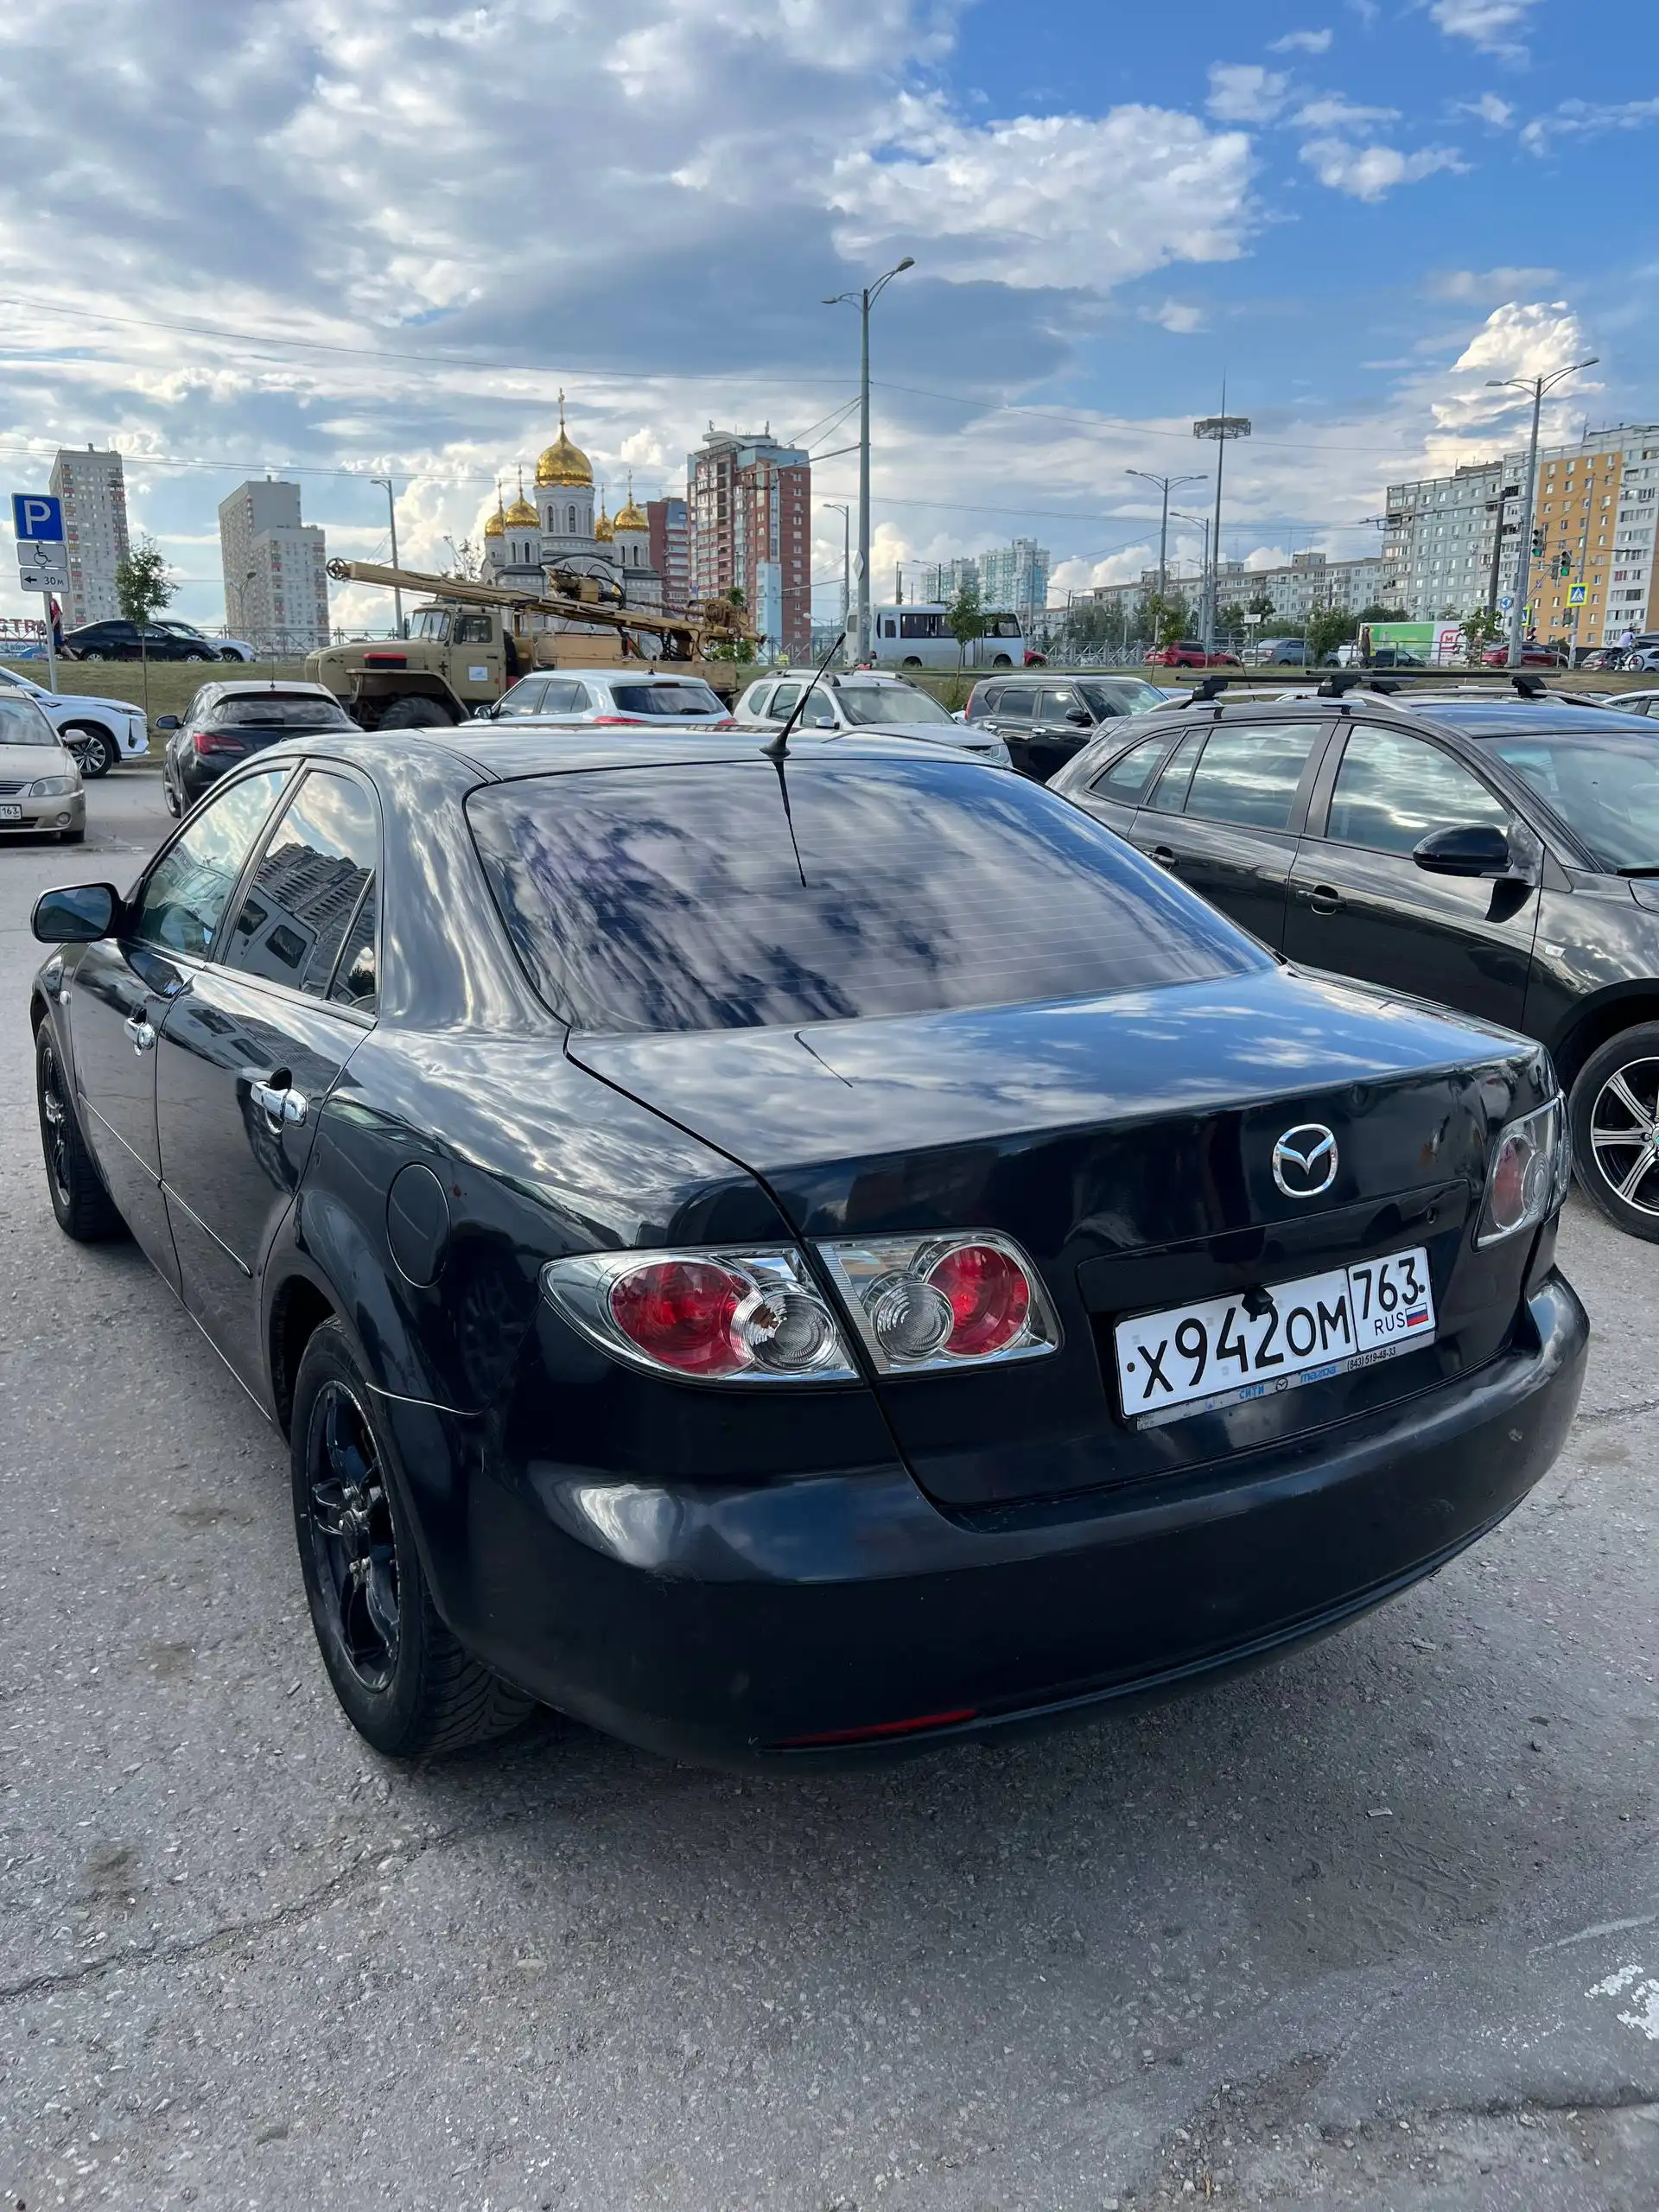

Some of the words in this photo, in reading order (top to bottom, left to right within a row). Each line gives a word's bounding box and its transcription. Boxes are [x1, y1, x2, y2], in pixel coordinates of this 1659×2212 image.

[24, 500, 51, 535] P
[1353, 1257, 1418, 1319] 763
[1375, 1312, 1406, 1336] RUS
